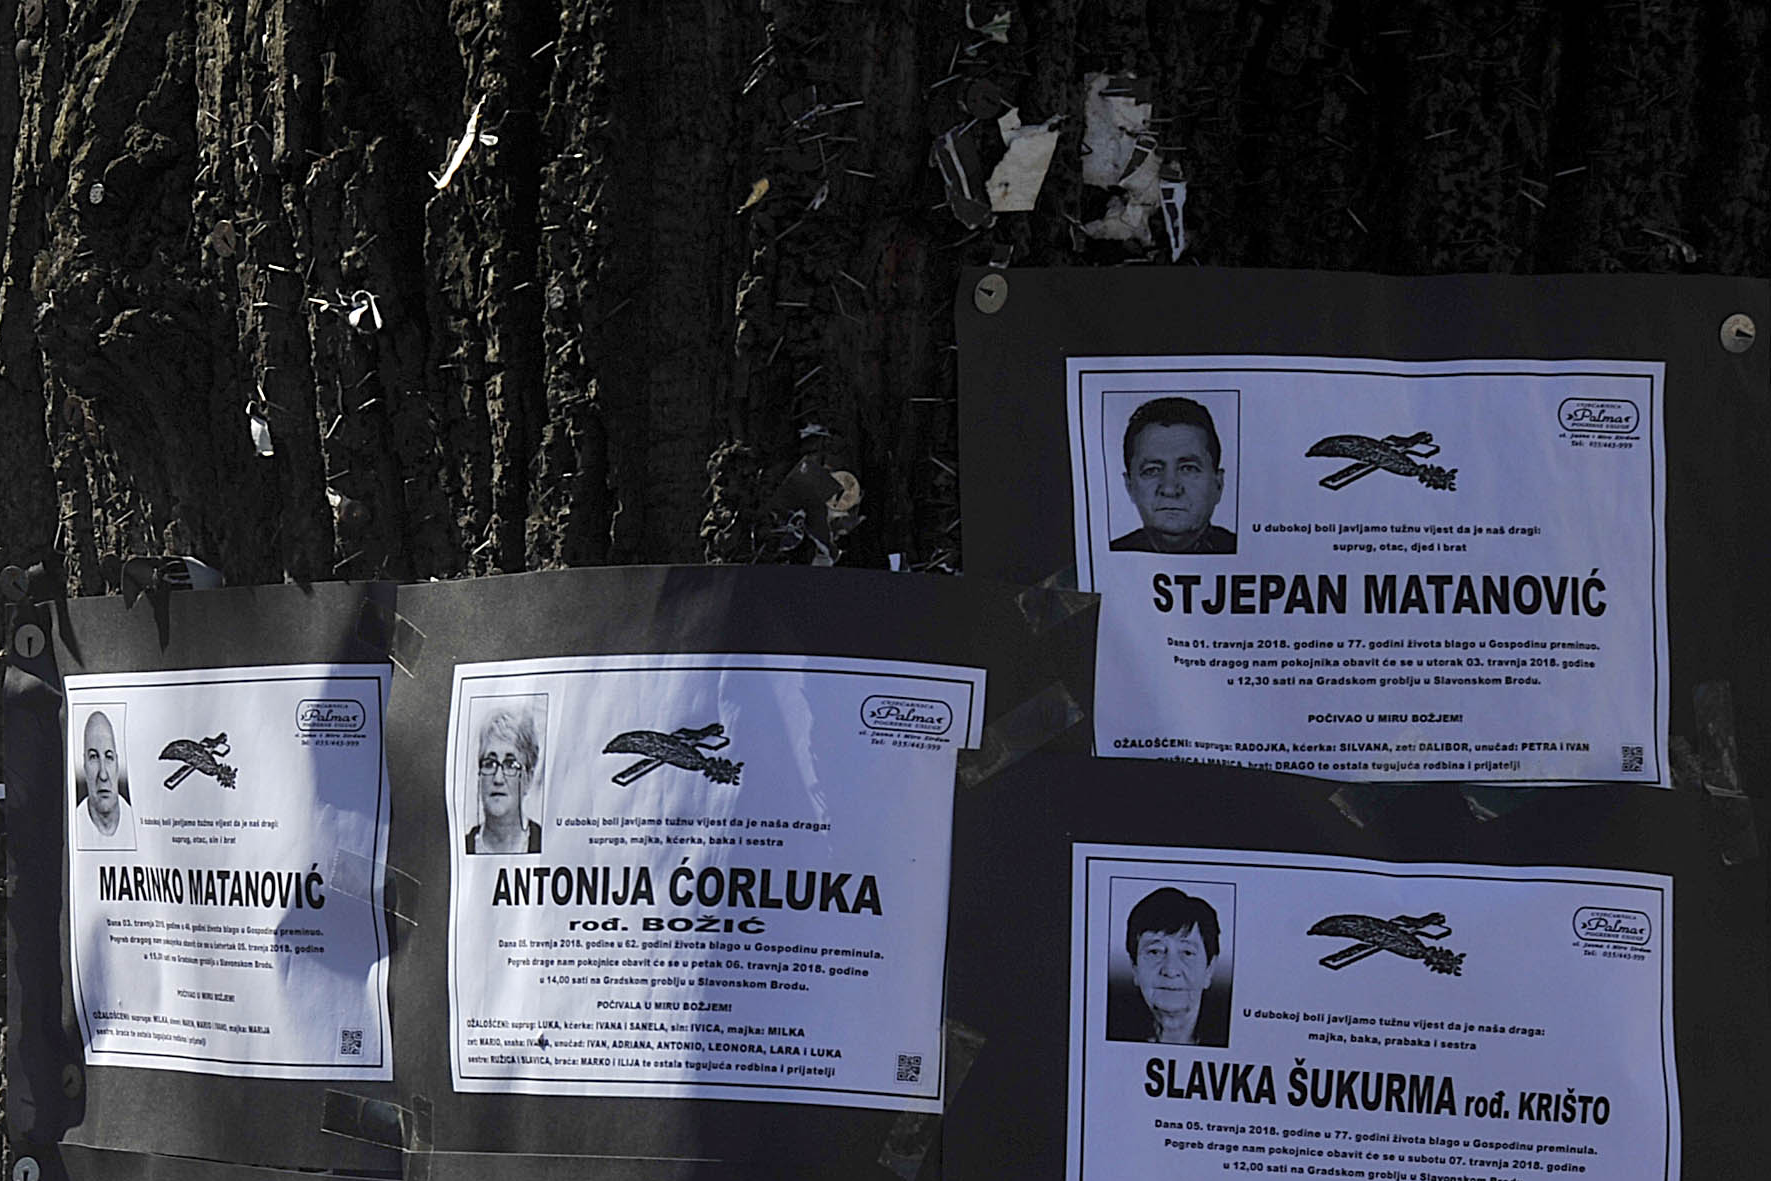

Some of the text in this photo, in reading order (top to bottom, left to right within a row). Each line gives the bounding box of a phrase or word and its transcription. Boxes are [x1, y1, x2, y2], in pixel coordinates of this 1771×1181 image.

[1574, 408, 1623, 423] Palma
[1263, 523, 1311, 534] dubokoj
[1314, 523, 1336, 532] boli
[1337, 523, 1388, 535] javljamo
[1389, 524, 1421, 533] tužnu
[1423, 525, 1453, 535] vijest
[1456, 524, 1470, 534] da
[1472, 525, 1483, 536] je
[1485, 525, 1505, 535] naš
[1410, 542, 1434, 553] djed
[1442, 543, 1466, 551] brat
[1152, 567, 1606, 617] STJEPAN MATANOVIĆ
[1237, 676, 1270, 687] 12,30
[1272, 676, 1295, 685] sati
[1315, 675, 1376, 685] Gradskom
[1379, 676, 1421, 687] groblju
[1433, 675, 1502, 685] Slavonskom
[304, 708, 350, 722] Palma
[876, 706, 935, 724] Palma
[1307, 712, 1362, 723] POČIVAO
[1377, 713, 1408, 722] MIRU
[708, 835, 735, 845] baka
[745, 837, 783, 846] sestra
[99, 863, 325, 910] MARINKO MATANOVIĆ
[491, 856, 882, 917] ANTONIJA ĆORLUKA
[569, 914, 764, 934] rođ. BOŽIĆ
[1587, 918, 1638, 934] Palma
[602, 975, 648, 985] Gradskom
[650, 976, 686, 988] groblju
[697, 977, 767, 988] Slavonskom
[596, 999, 641, 1010] POČIVALA
[654, 1001, 680, 1010] MIRU
[1383, 1036, 1430, 1047] prabaka
[1440, 1040, 1476, 1050] sestra
[1144, 1057, 1610, 1125] SLAVKA ŠUKURMA rođ. KRIŠTO
